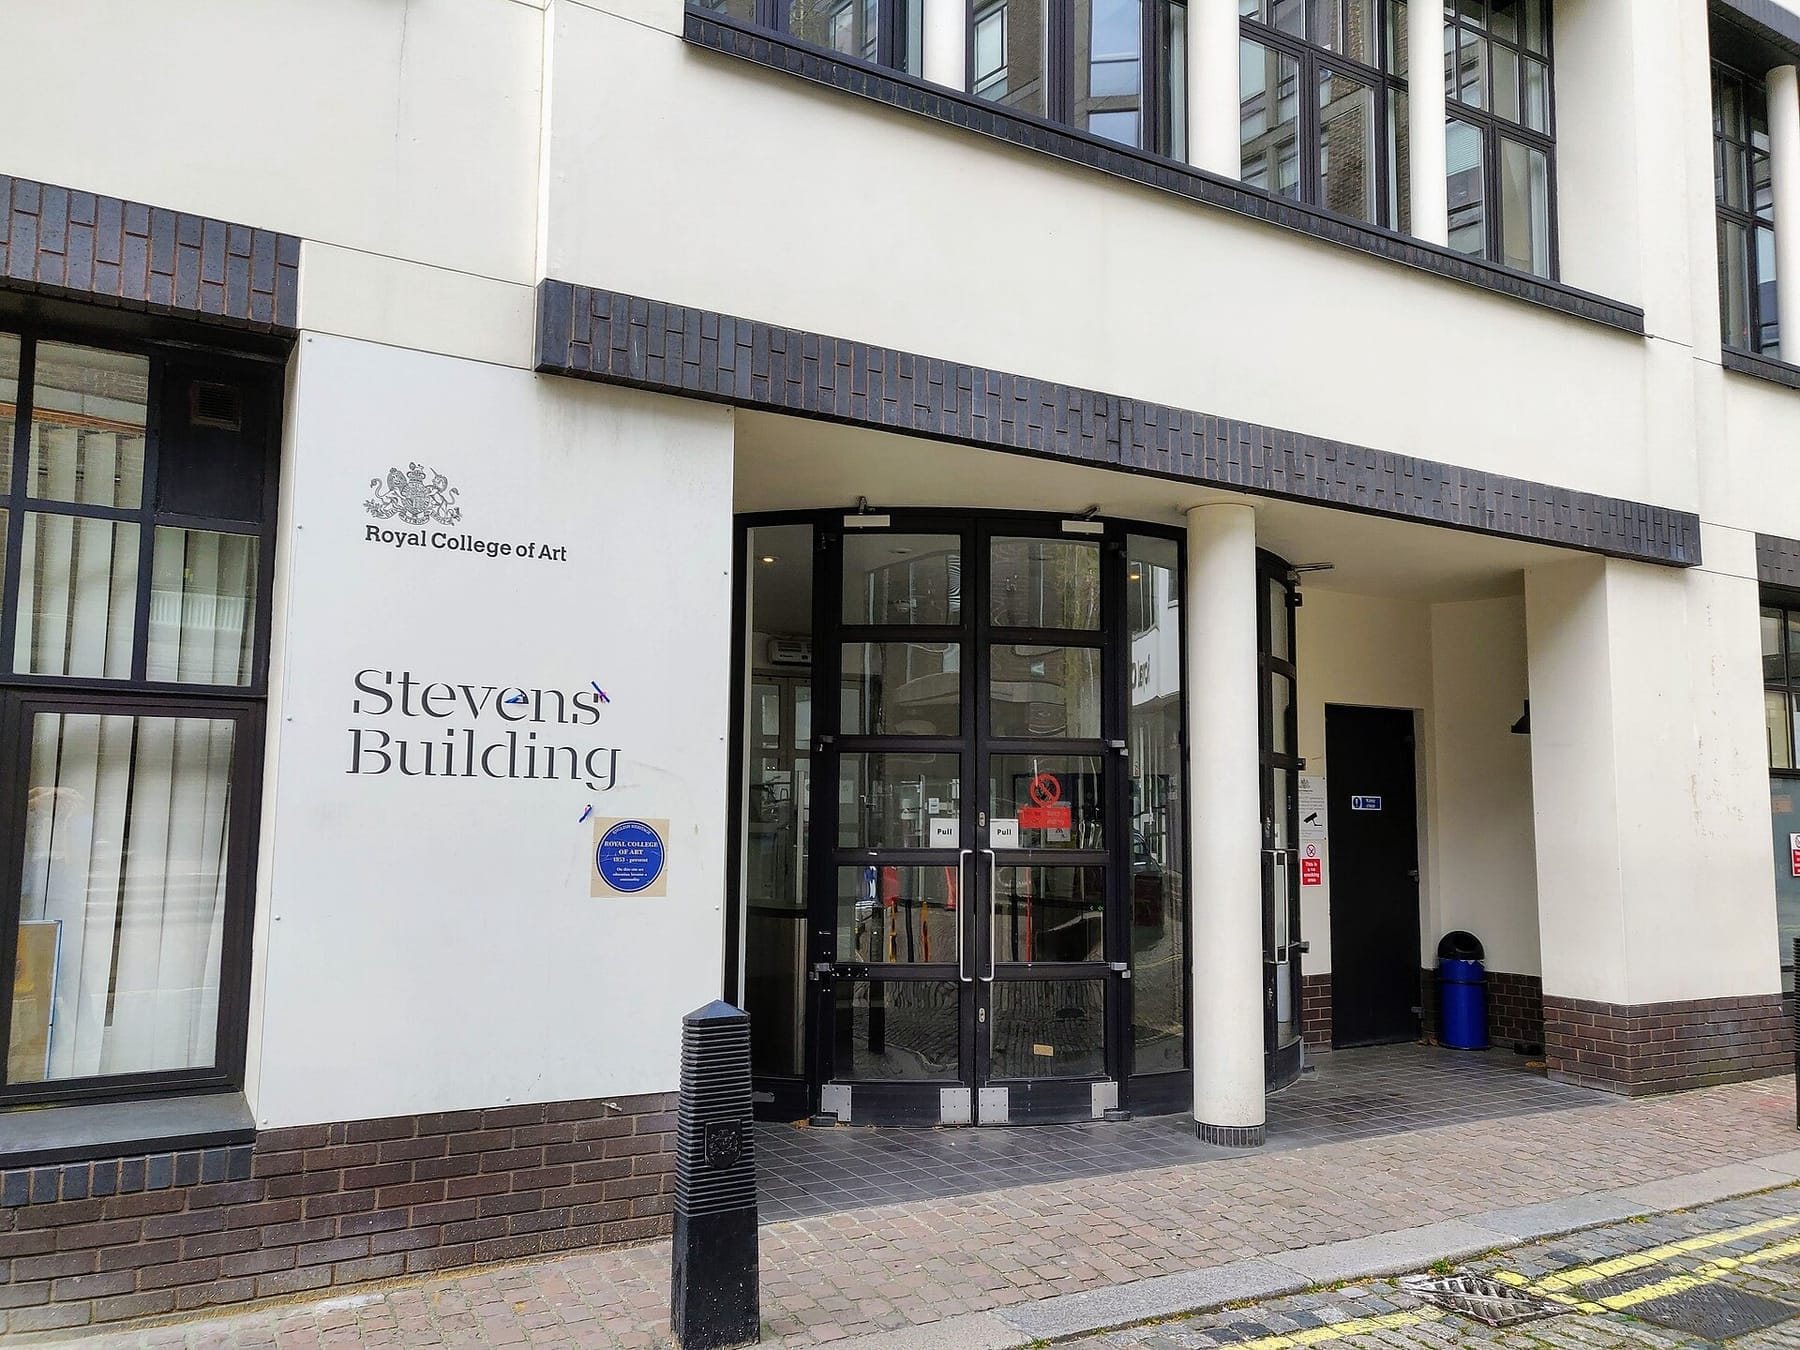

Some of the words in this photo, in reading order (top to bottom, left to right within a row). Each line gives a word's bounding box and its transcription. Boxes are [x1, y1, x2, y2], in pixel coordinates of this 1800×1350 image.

[365, 525, 427, 548] Royal
[431, 532, 512, 559] College
[516, 542, 535, 558] of
[538, 545, 567, 562] Art
[353, 669, 601, 725] Stevens
[345, 728, 622, 791] Building
